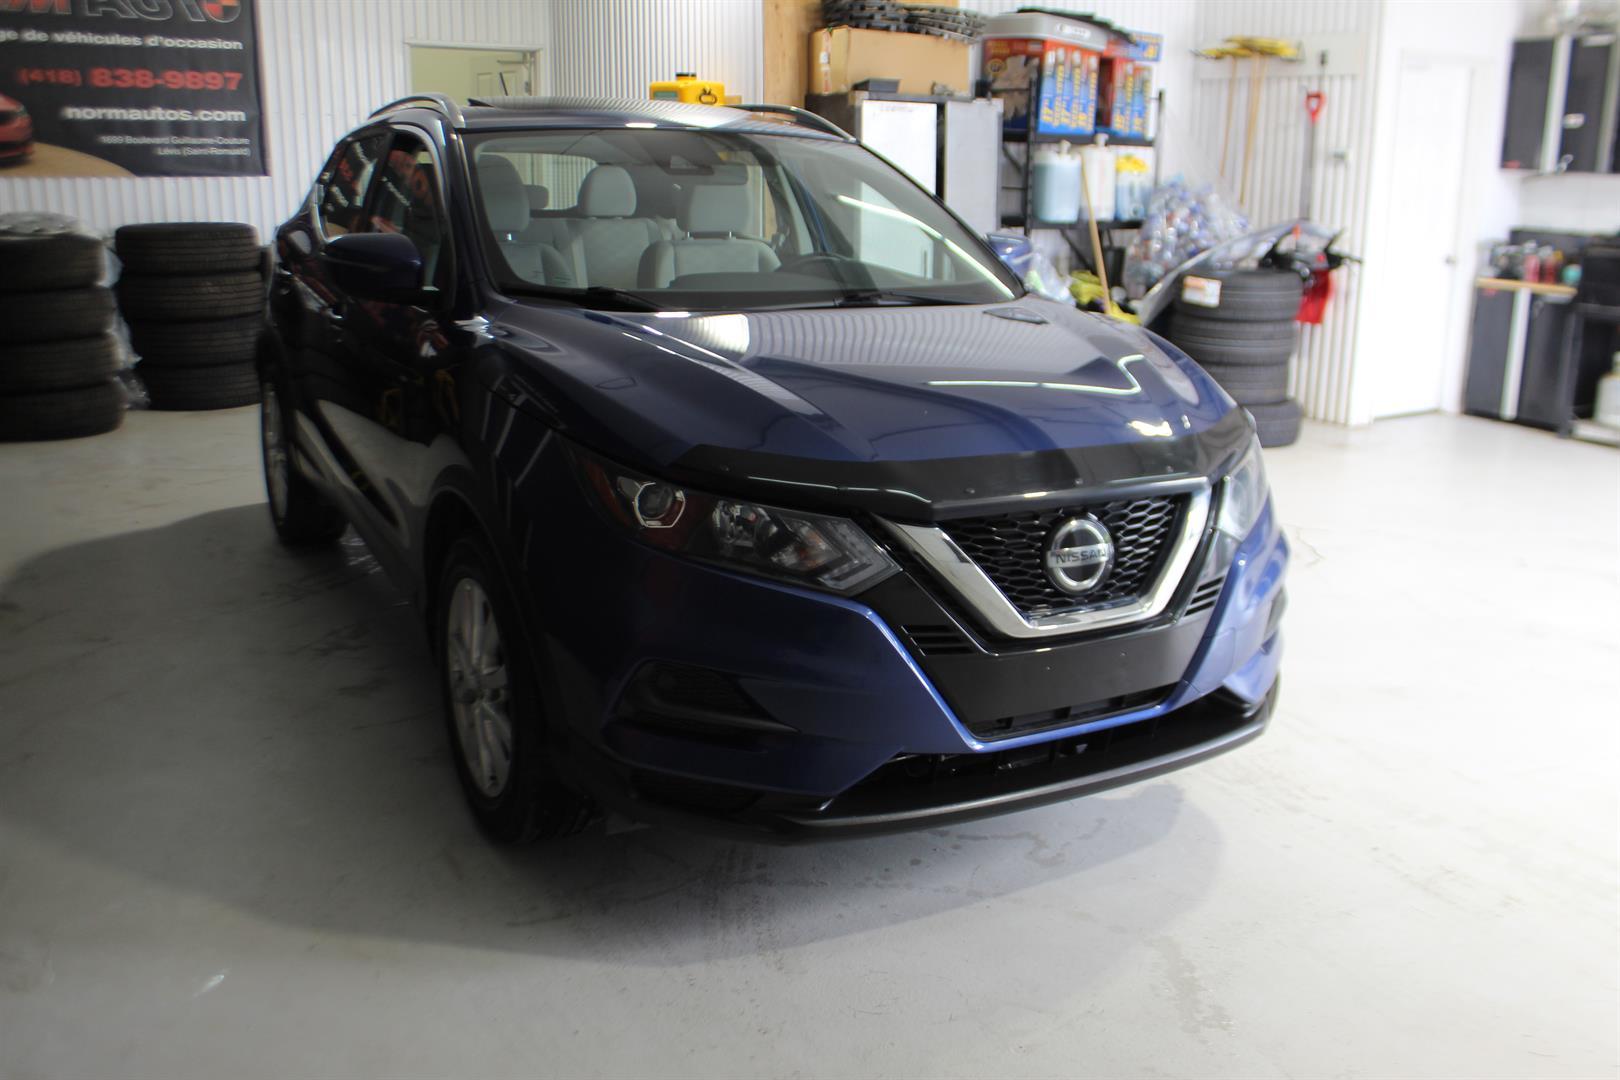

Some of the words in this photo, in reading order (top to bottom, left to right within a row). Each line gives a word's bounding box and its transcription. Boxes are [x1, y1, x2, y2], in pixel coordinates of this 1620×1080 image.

[22, 29, 49, 41] de
[53, 32, 142, 46] véhicules
[146, 35, 243, 49] d'occasion
[19, 68, 81, 87] (418)
[91, 68, 242, 90] 838-9897
[65, 106, 246, 121] normautos.com
[1055, 549, 1106, 564] NISSAN
